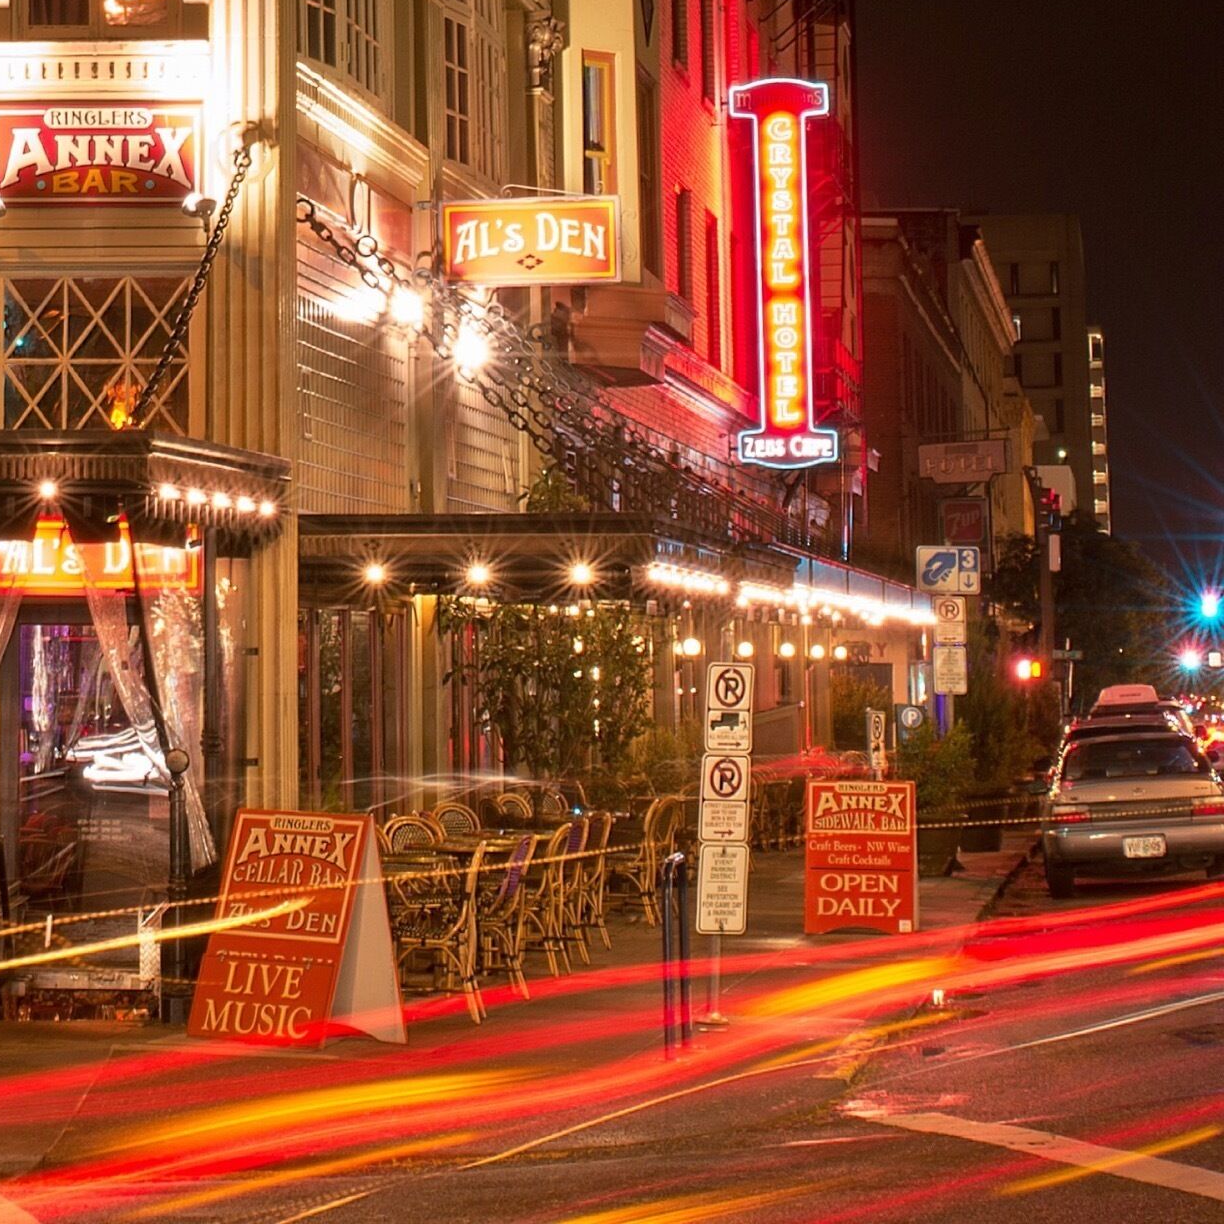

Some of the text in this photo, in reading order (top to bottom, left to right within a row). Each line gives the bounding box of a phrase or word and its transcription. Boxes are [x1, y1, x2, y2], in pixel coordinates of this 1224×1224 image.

[50, 110, 148, 126] RINGLERS
[0, 128, 194, 190] ANNEX
[52, 168, 139, 193] BAR
[766, 117, 796, 284] CRYSTAL
[534, 211, 607, 261] DEN
[772, 302, 801, 422] HOTEL
[961, 550, 975, 568] 3
[814, 791, 906, 819] ANNEX
[273, 817, 332, 831] RINGLERS
[814, 811, 907, 832] SIDEWALK BAR
[236, 827, 355, 873] ANNEX
[809, 839, 911, 853] Craft Beers NW Wine
[827, 853, 892, 866] Craft Cocktails
[232, 858, 345, 889] CELLAR BAR
[820, 873, 899, 893] OPEN
[816, 896, 903, 918] DAILY
[286, 908, 337, 933] DEN
[223, 960, 305, 1000] LIVE
[200, 998, 313, 1040] MUSIC
